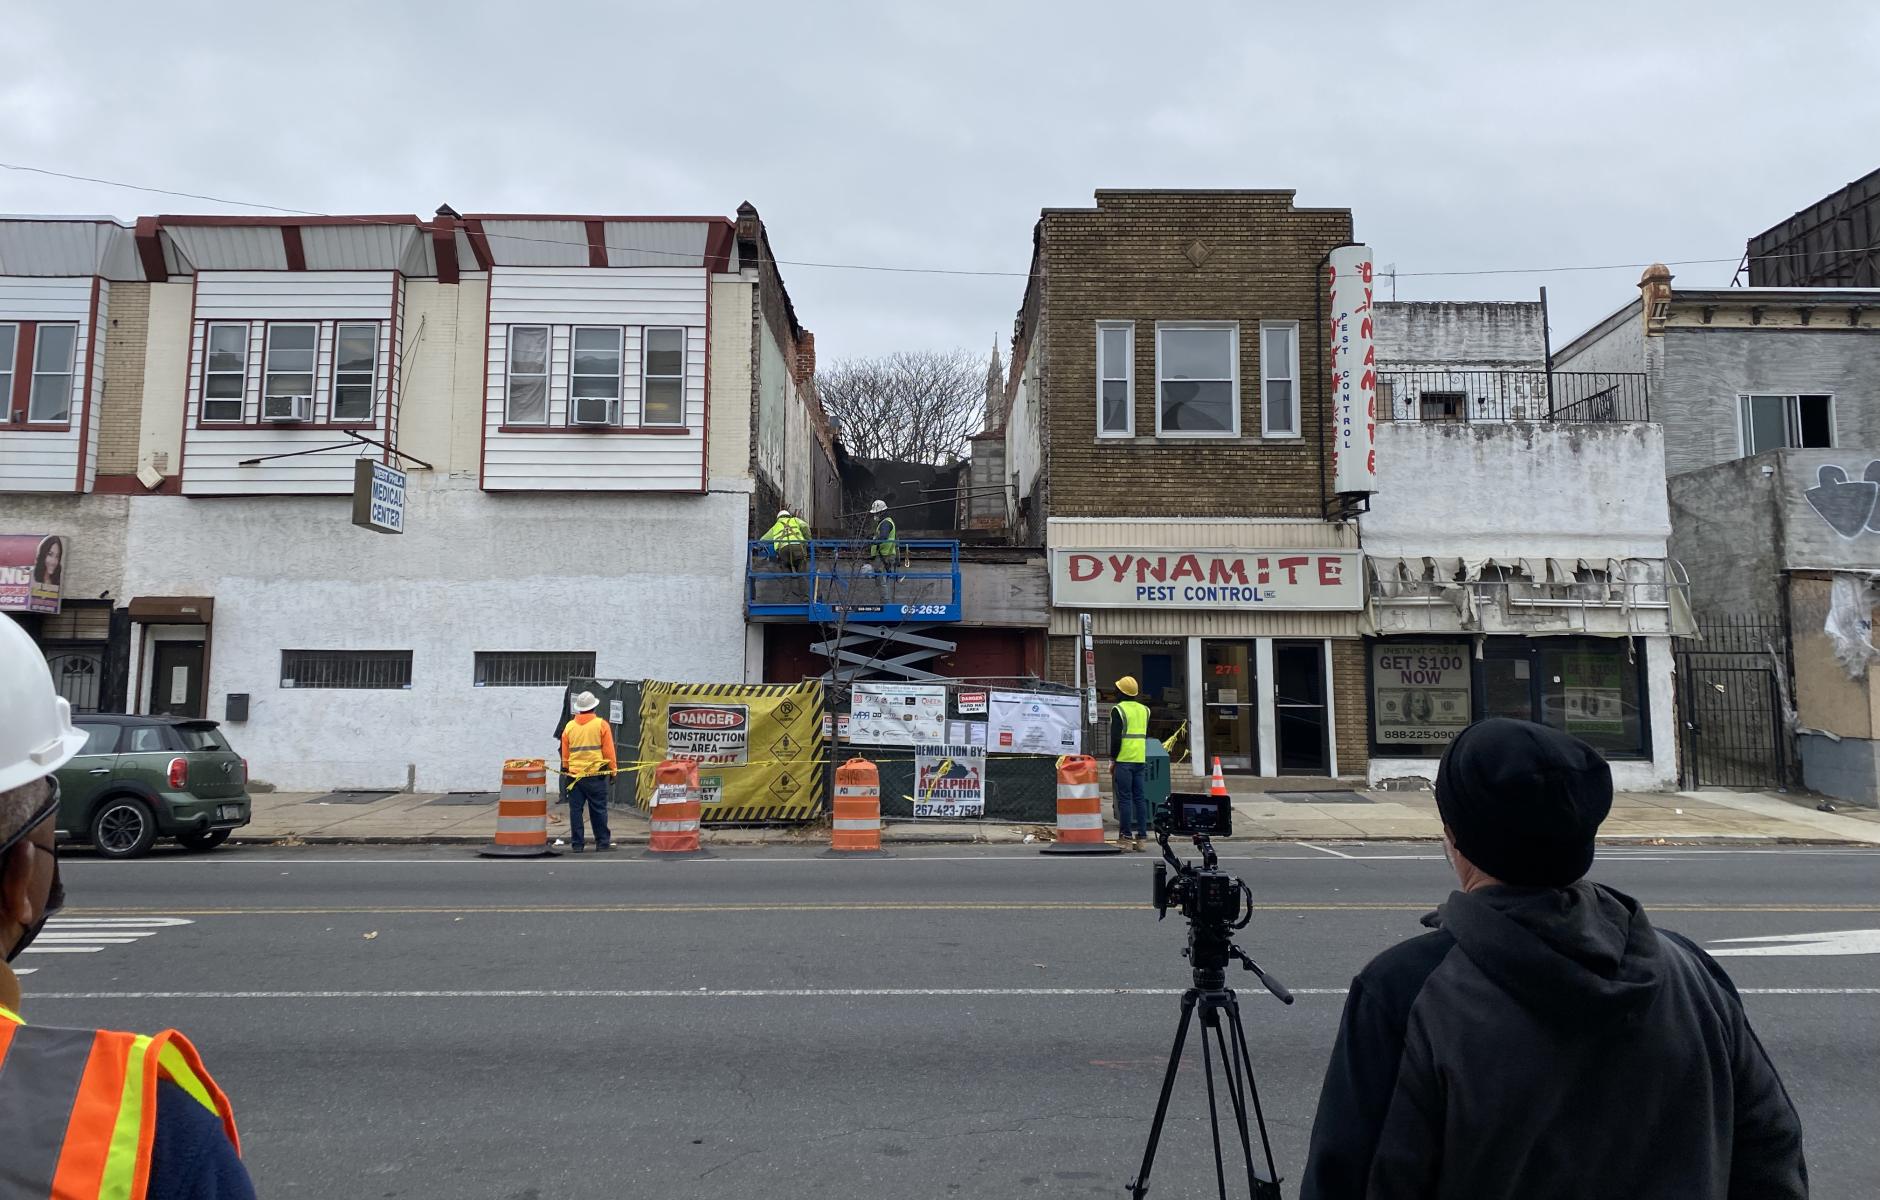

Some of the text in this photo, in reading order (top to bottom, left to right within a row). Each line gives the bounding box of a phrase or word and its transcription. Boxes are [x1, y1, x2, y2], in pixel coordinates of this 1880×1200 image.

[1343, 371, 1351, 448] CONTROL
[373, 481, 402, 507] MEDICAL
[372, 503, 400, 527] CENTER
[1069, 554, 1342, 585] DYNAMITE
[1136, 586, 1175, 600] PEST
[1184, 586, 1263, 601] CONTROL
[1383, 647, 1426, 655] INSTANT
[1380, 655, 1463, 670] GET $100
[1400, 670, 1441, 684] NOW
[679, 713, 734, 724] DANGER
[668, 731, 745, 742] CONSTRUCTION
[1384, 730, 1458, 739] 888-225-090
[691, 744, 717, 752] AREA
[916, 745, 985, 757] DEMOLITION BY:
